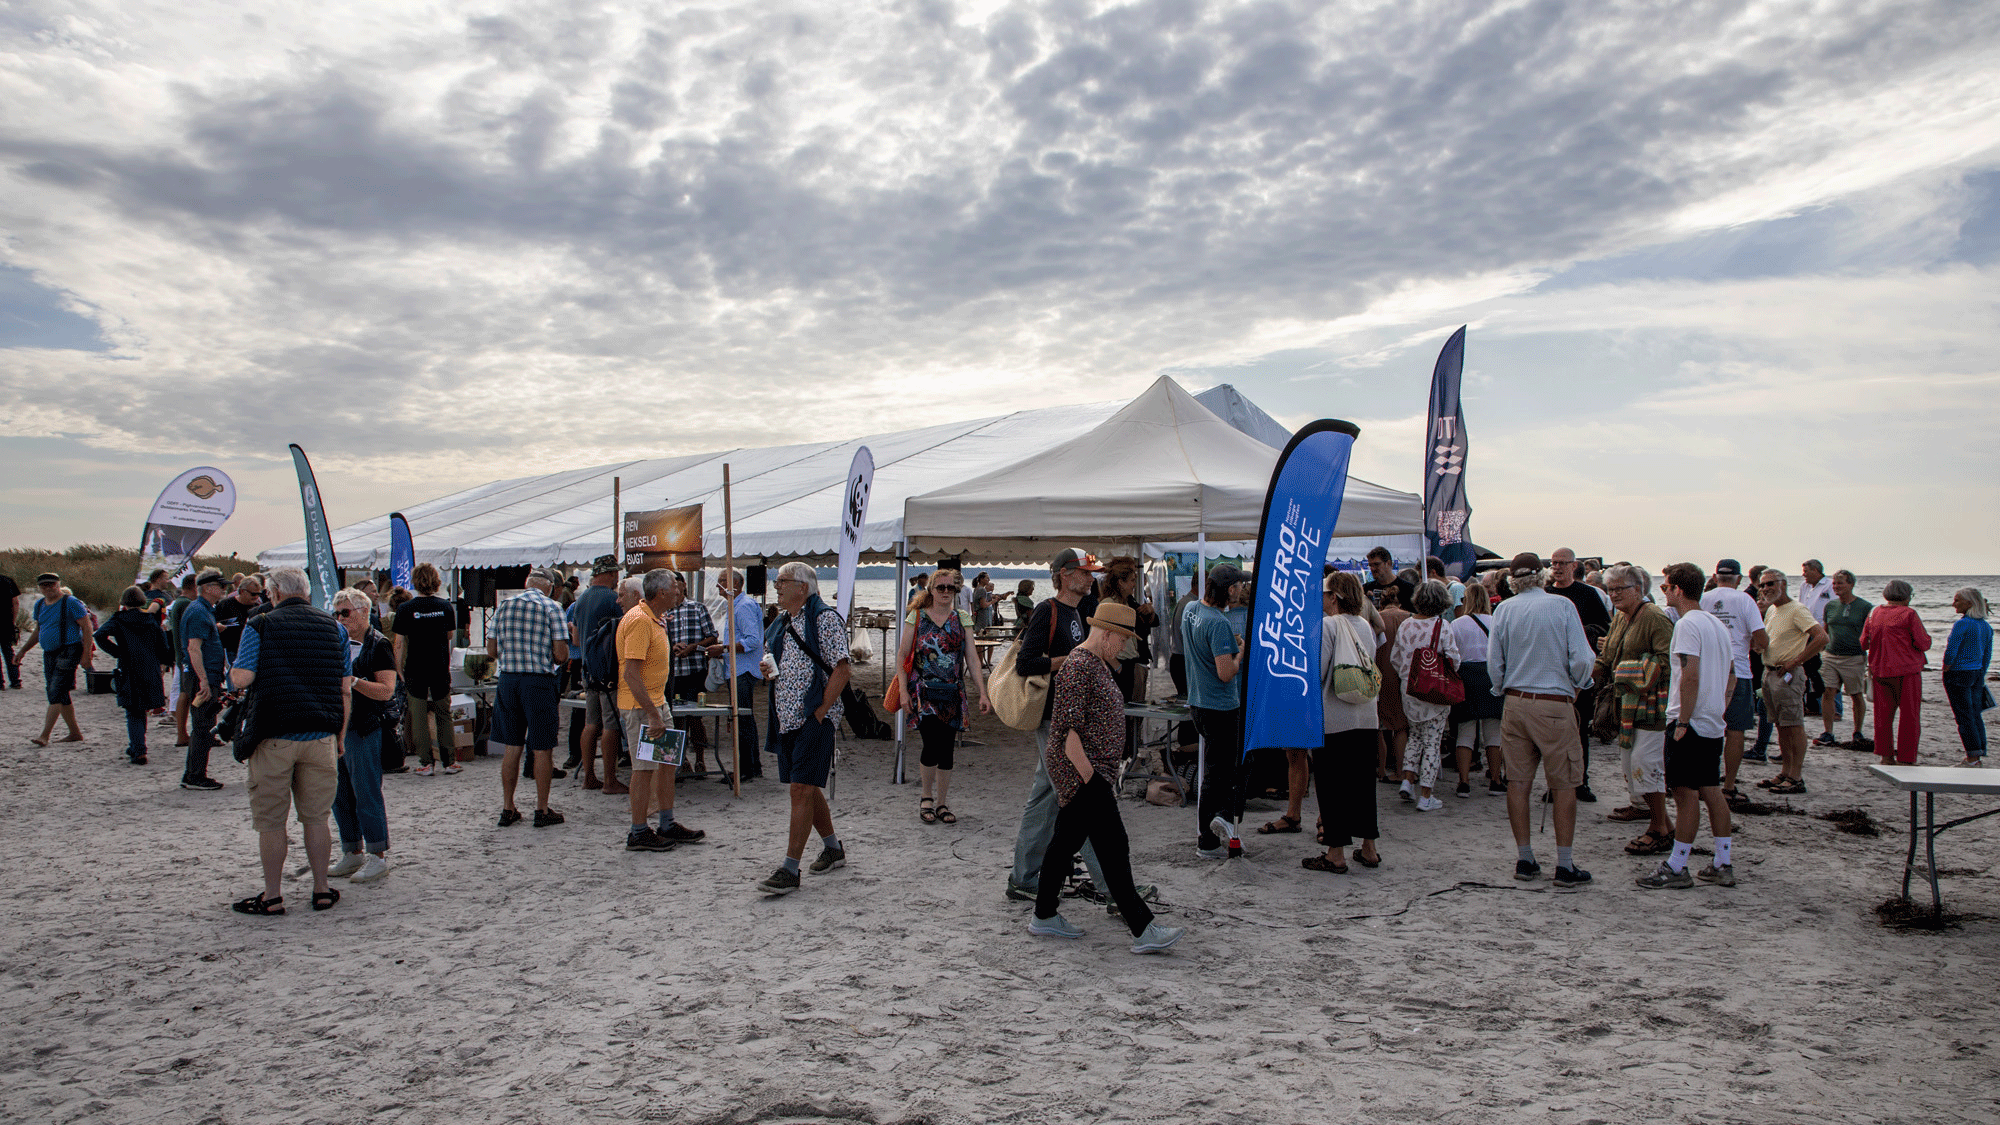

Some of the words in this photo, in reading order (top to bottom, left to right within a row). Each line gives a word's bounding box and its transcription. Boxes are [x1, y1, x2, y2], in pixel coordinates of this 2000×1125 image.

[626, 520, 639, 532] REN
[625, 534, 658, 549] NEKSELØ
[626, 553, 644, 565] BUGT
[1267, 517, 1321, 697] SEASCAPE
